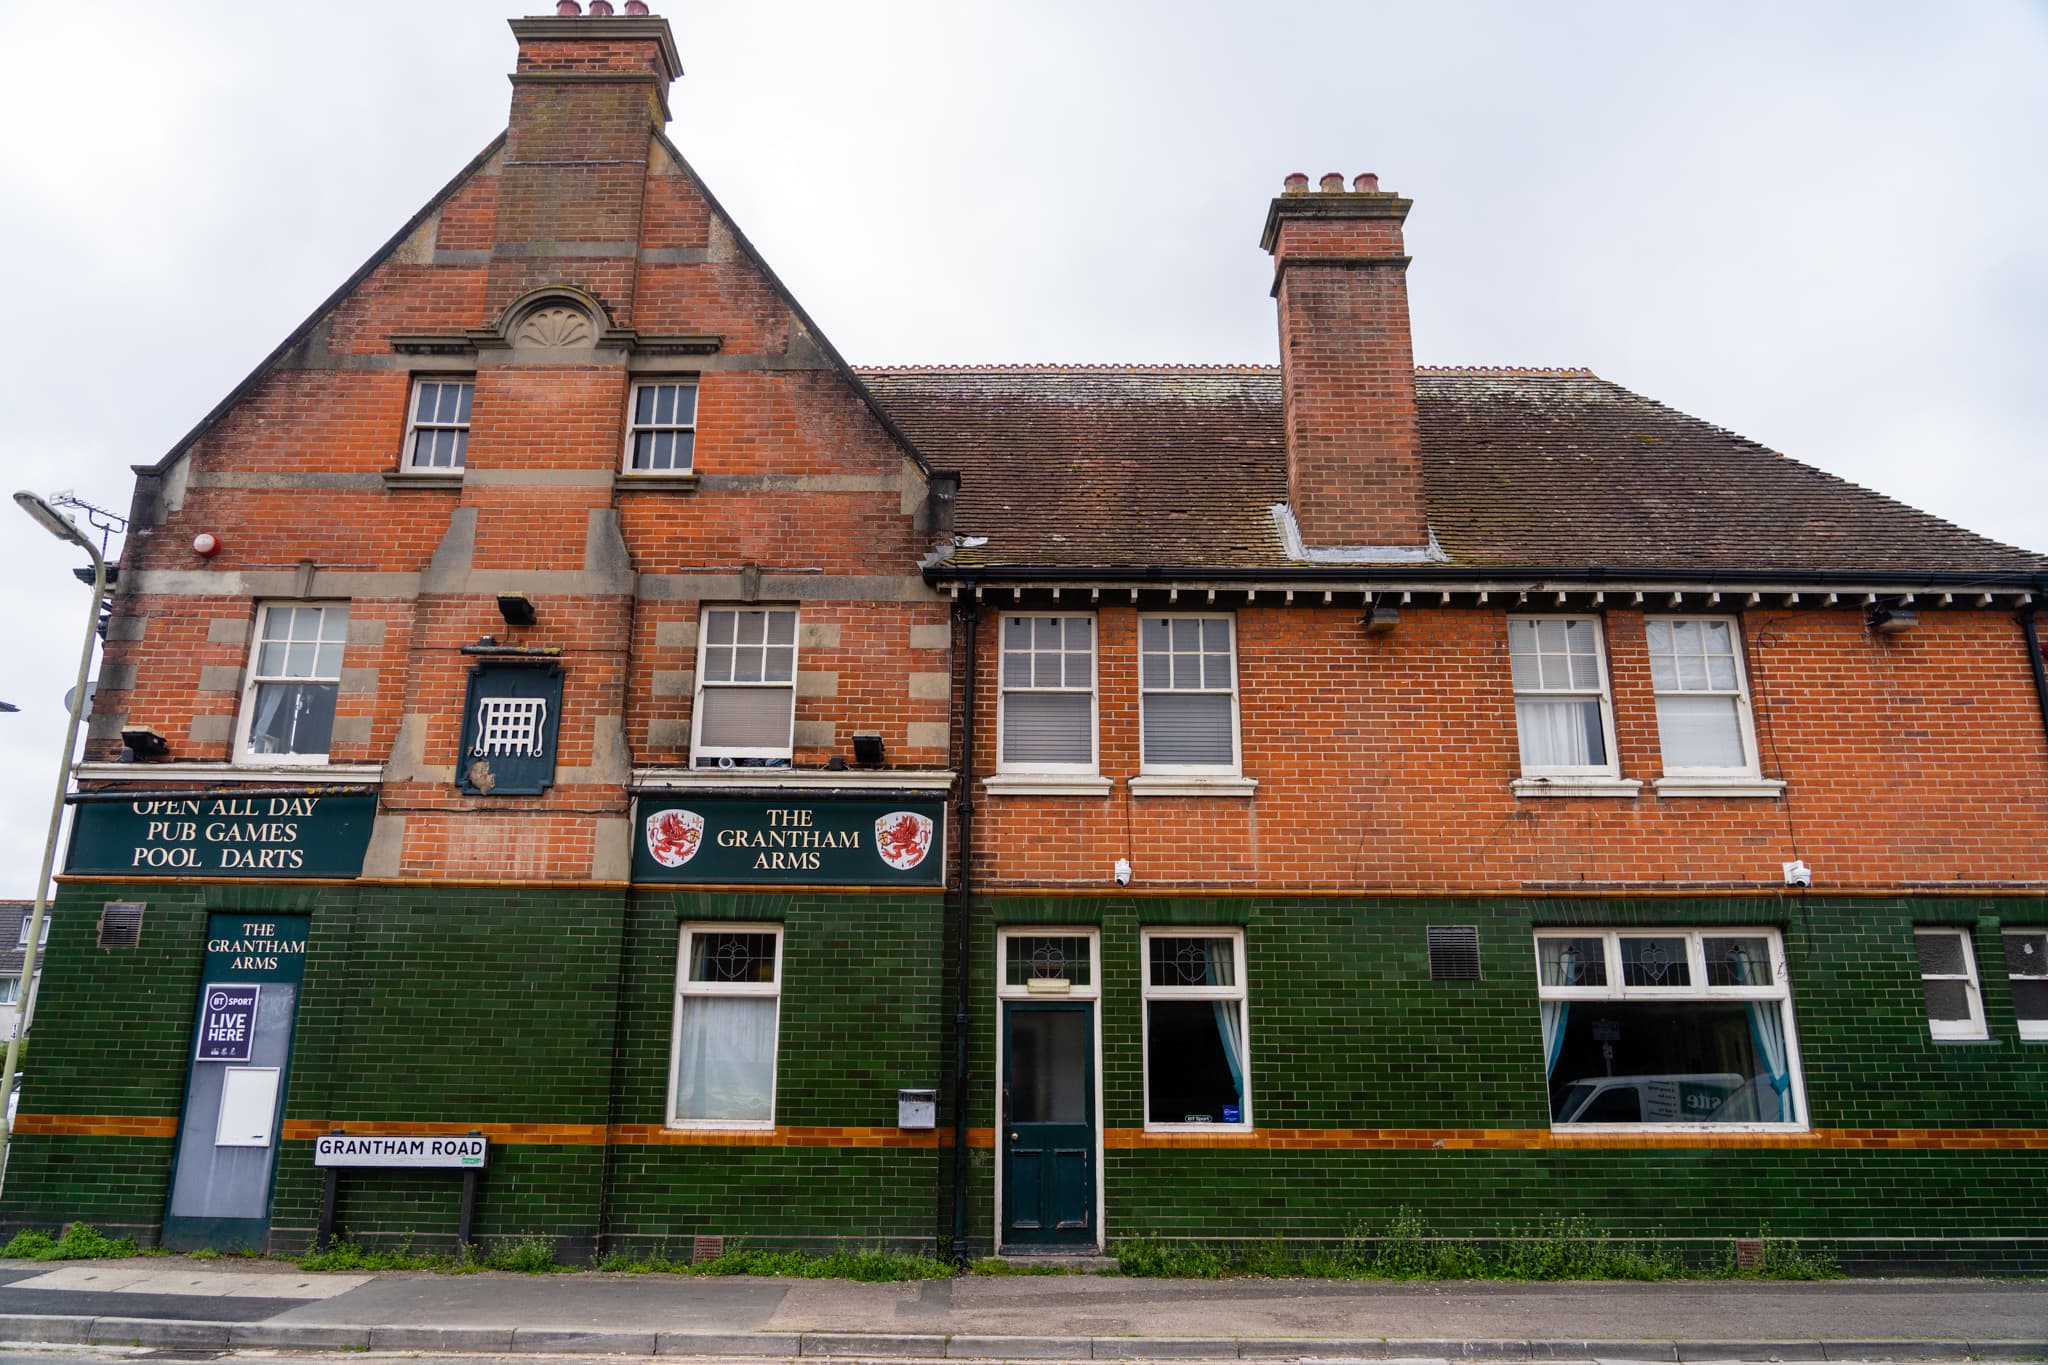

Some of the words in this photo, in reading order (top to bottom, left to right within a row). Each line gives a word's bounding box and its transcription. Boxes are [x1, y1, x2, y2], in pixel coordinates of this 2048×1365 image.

[133, 801, 200, 815] OPEN
[208, 799, 260, 816] ALL
[267, 797, 319, 817] DAY
[766, 809, 812, 828] THE
[146, 822, 197, 841] PUB
[205, 822, 298, 842] GAMES
[717, 829, 860, 849] GRANTHAM
[131, 847, 202, 867] POOL
[219, 849, 304, 869] DARTS
[753, 852, 821, 870] ARMS
[243, 923, 276, 937] THE
[207, 939, 306, 954] GRANTHAM
[231, 956, 278, 970] ARMS
[227, 997, 253, 1006] SPORT
[210, 1013, 247, 1029] LIVE
[208, 1029, 245, 1042] HERE
[319, 1140, 425, 1155] GRANTHAM
[431, 1141, 483, 1155] ROAD
